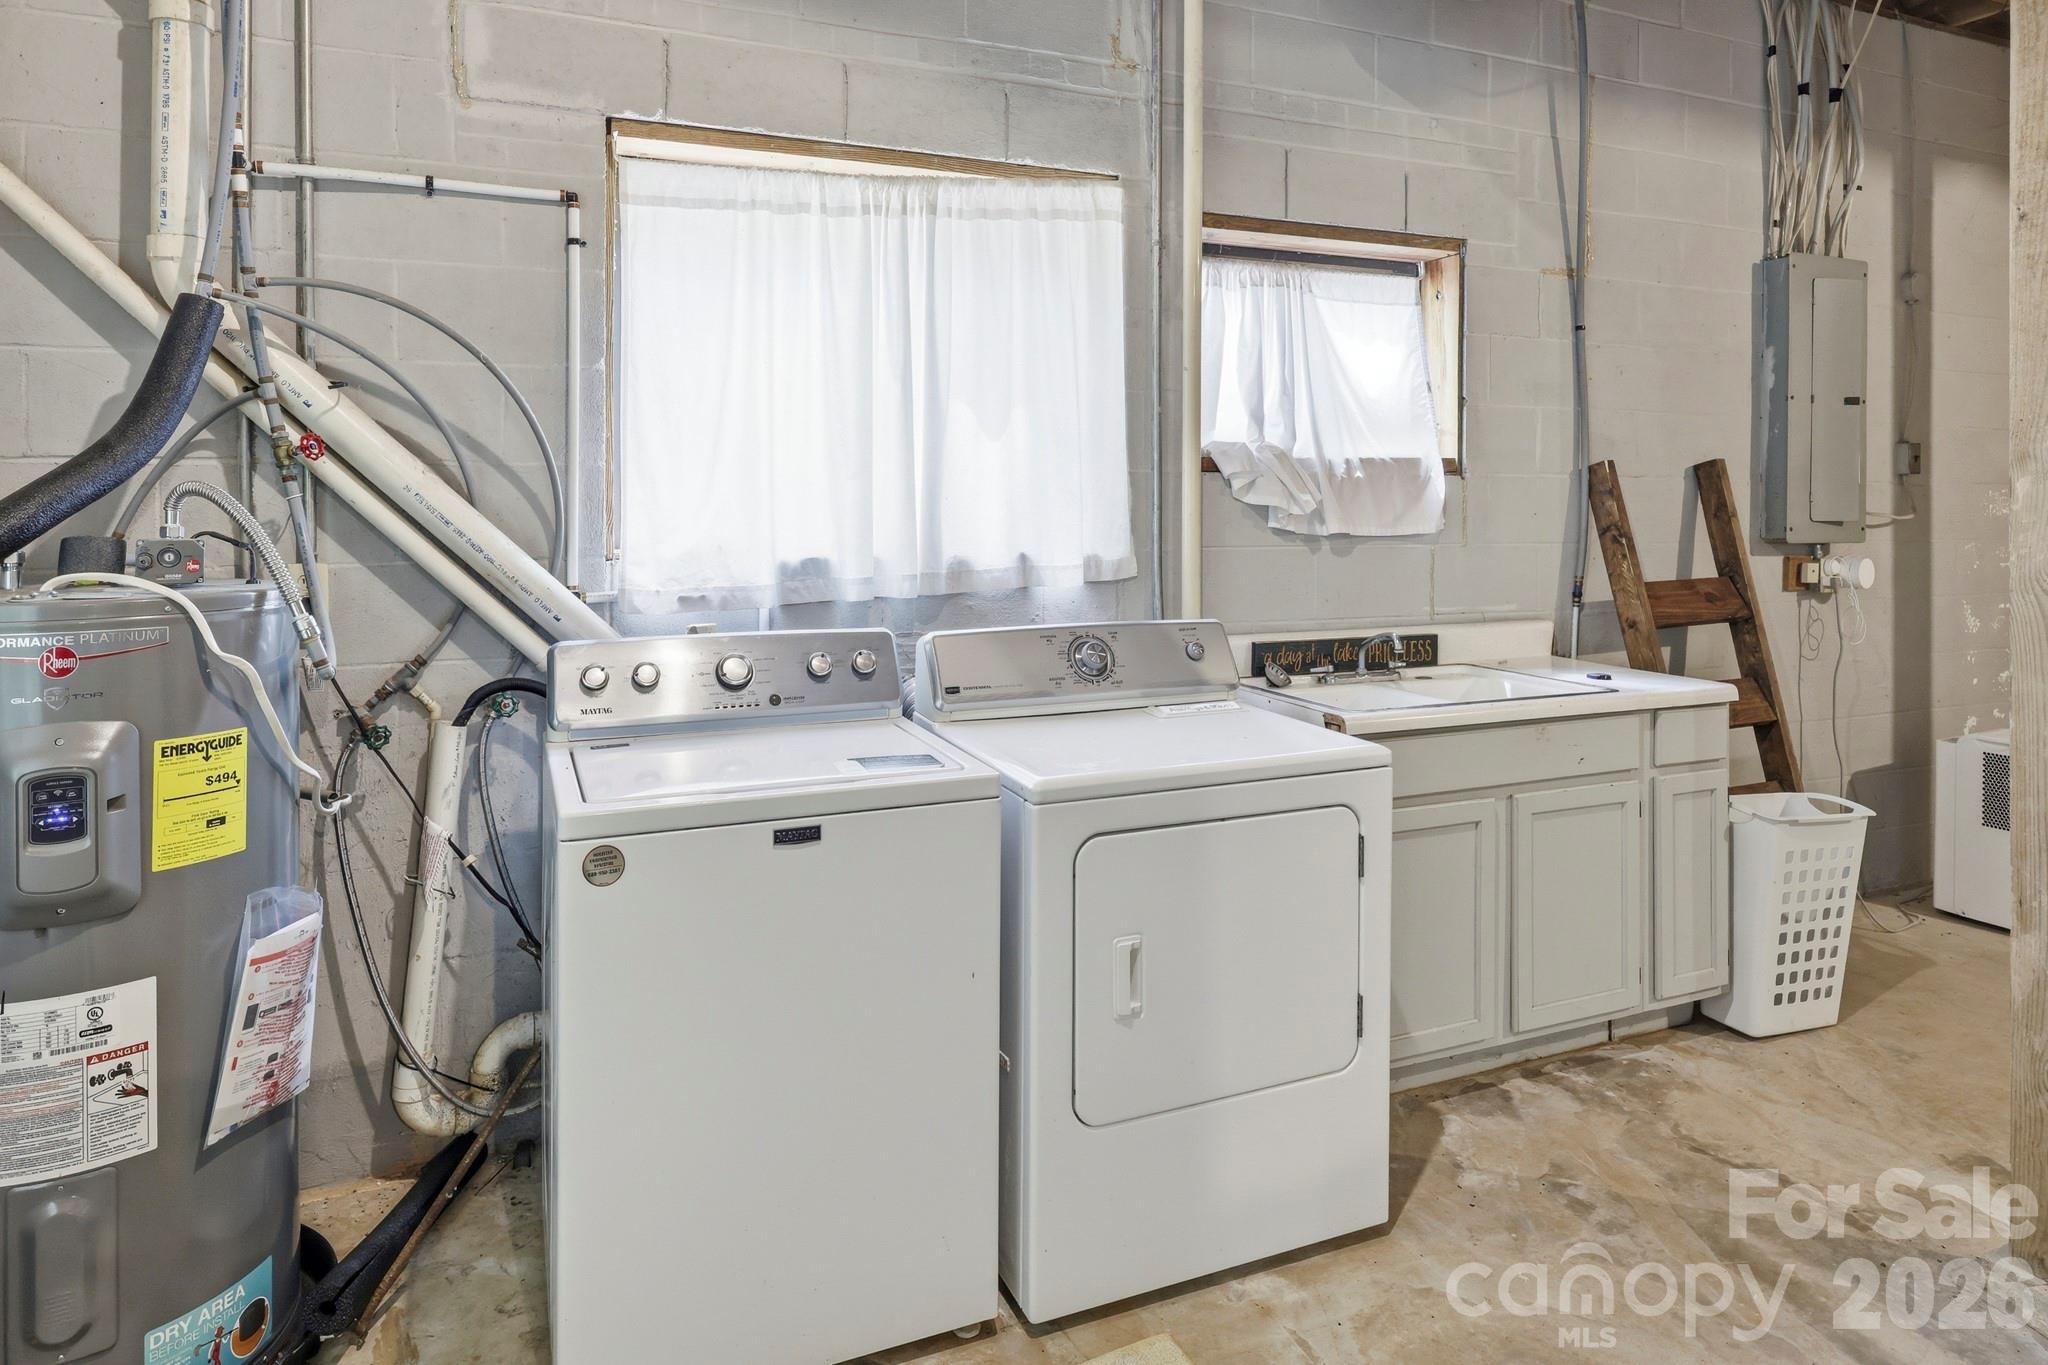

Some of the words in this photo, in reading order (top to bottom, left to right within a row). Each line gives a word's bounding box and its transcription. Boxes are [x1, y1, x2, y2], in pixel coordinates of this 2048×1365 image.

[80, 630, 160, 645] PLATINUM
[43, 647, 77, 674] Rheem
[1276, 645, 1303, 672] day
[1333, 641, 1360, 663] lake
[10, 691, 104, 705] GLADITOR
[580, 707, 613, 716] MAYTAG
[161, 733, 243, 761] ENERGYGUIDE
[205, 770, 238, 786] $494
[102, 1043, 145, 1061] DANGER
[149, 1315, 192, 1350] DRY
[198, 1284, 246, 1326] AREA
[149, 1327, 201, 1363] BEFORE
[203, 1301, 244, 1335] INSTALL
